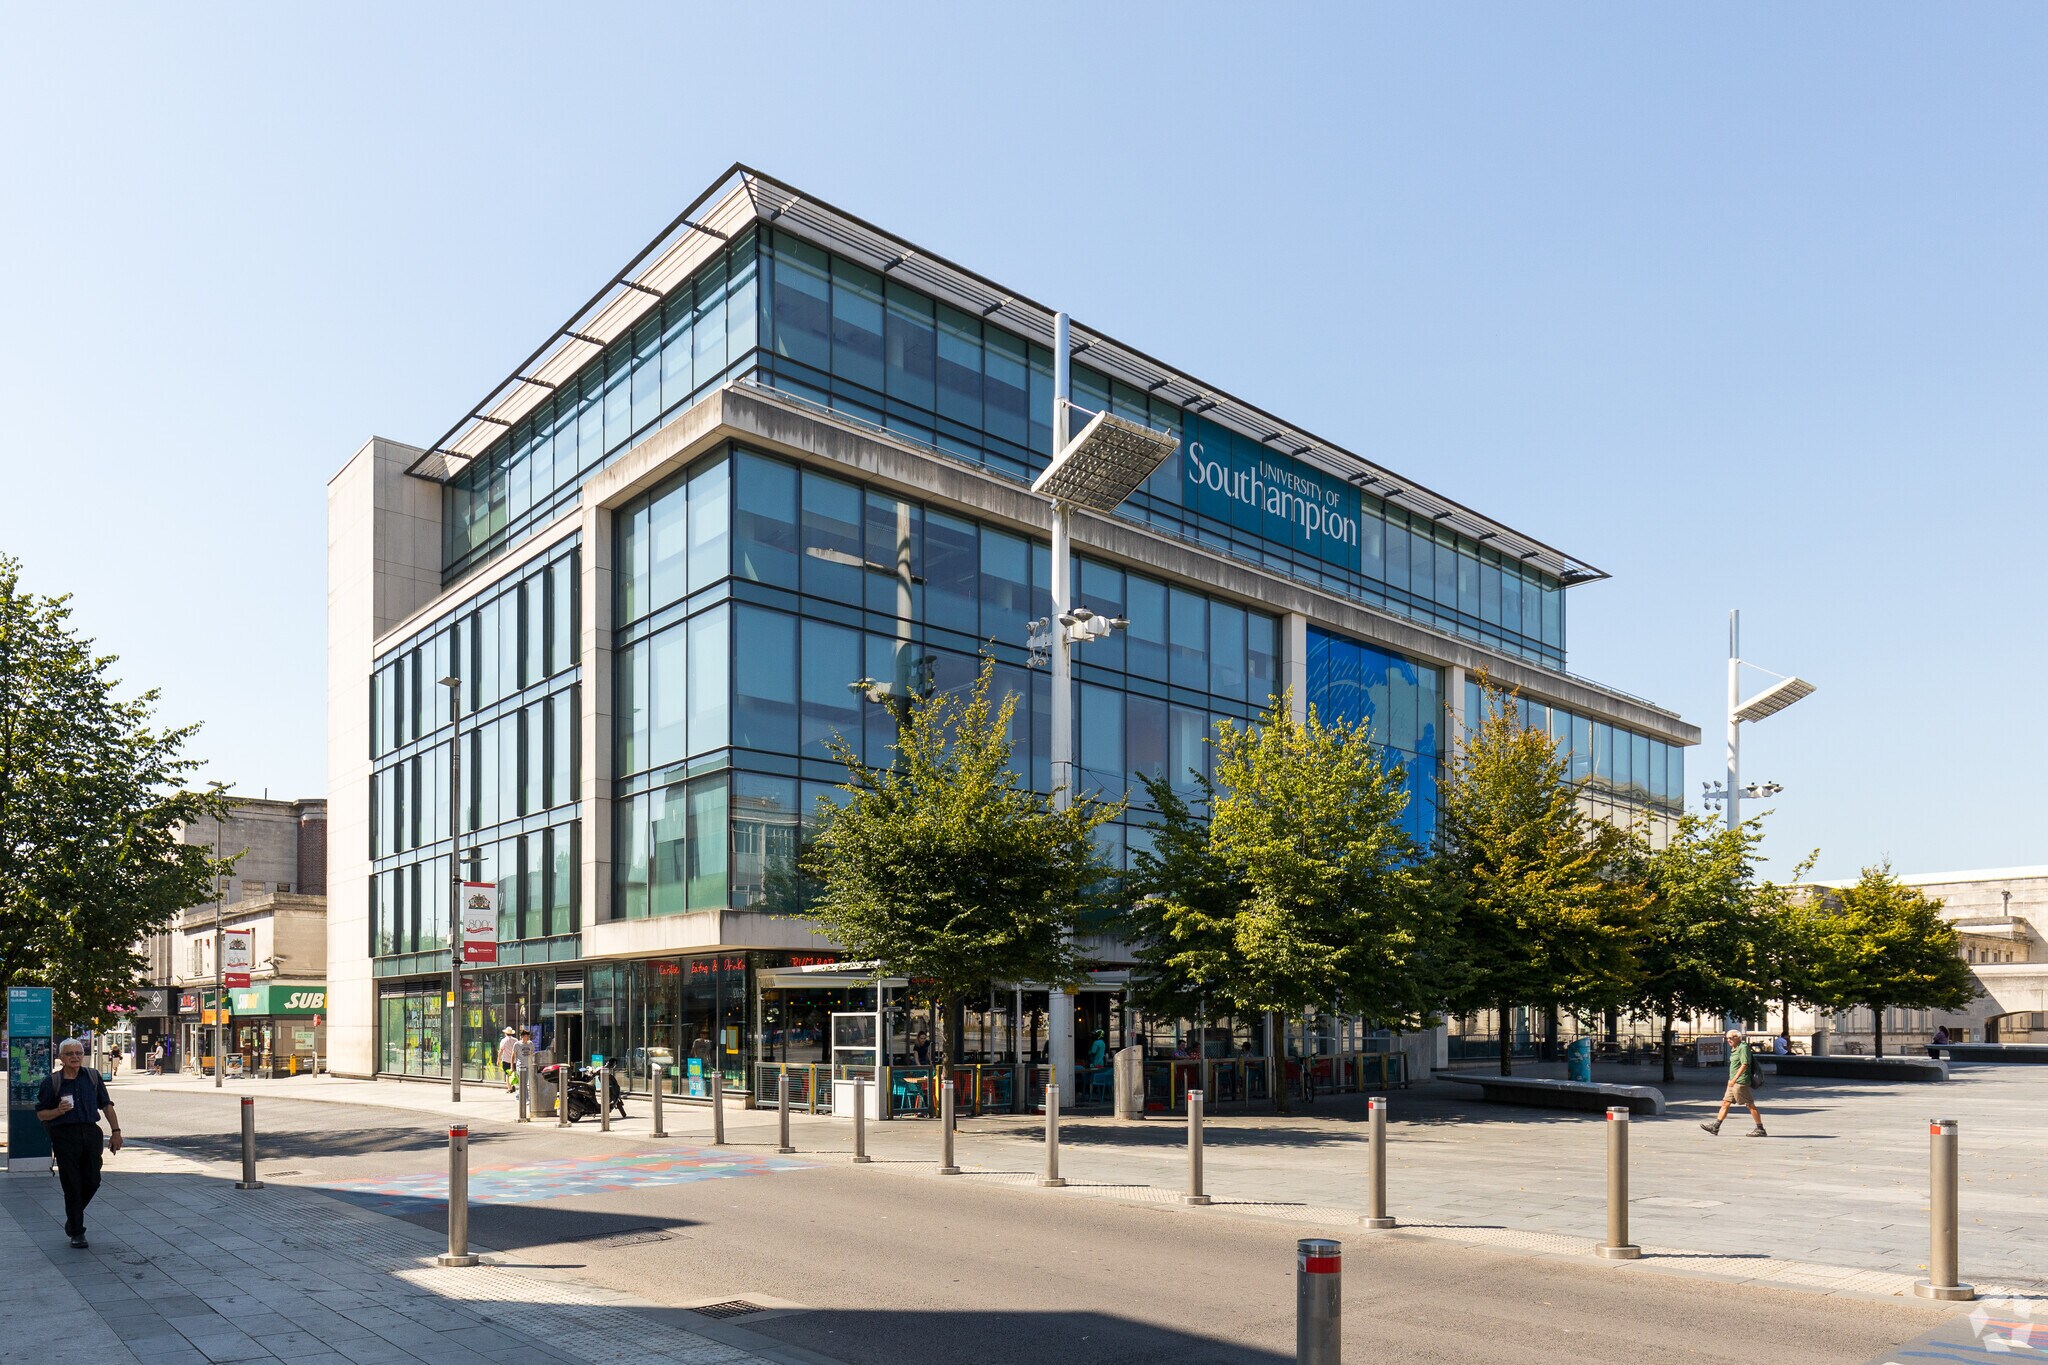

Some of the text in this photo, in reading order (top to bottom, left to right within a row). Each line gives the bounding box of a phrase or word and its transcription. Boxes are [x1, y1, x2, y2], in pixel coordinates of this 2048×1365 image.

[1188, 441, 1358, 547] Southampton
[1259, 460, 1340, 509] UNIVERSITY OF
